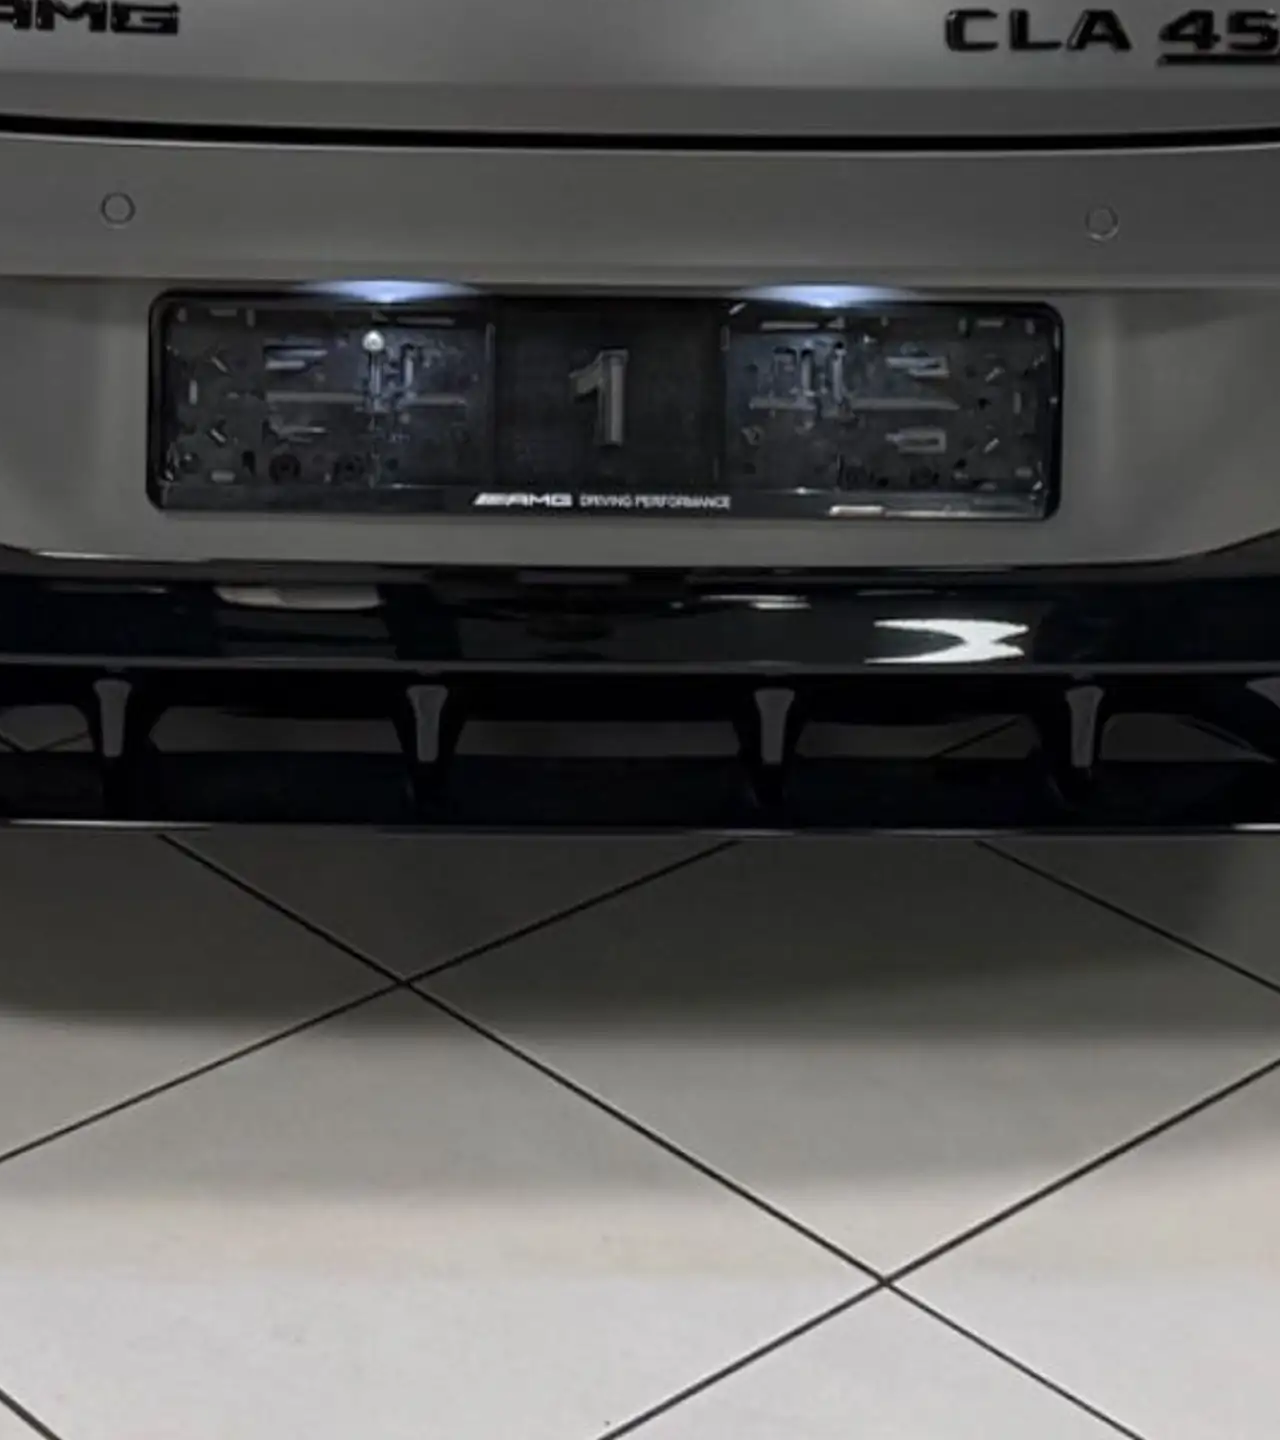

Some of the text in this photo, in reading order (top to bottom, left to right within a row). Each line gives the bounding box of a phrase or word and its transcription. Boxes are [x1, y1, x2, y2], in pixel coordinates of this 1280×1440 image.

[944, 8, 1133, 52] CLA
[567, 348, 629, 447] 1
[504, 492, 732, 509] AMG DRIVING PERFORMANCE
